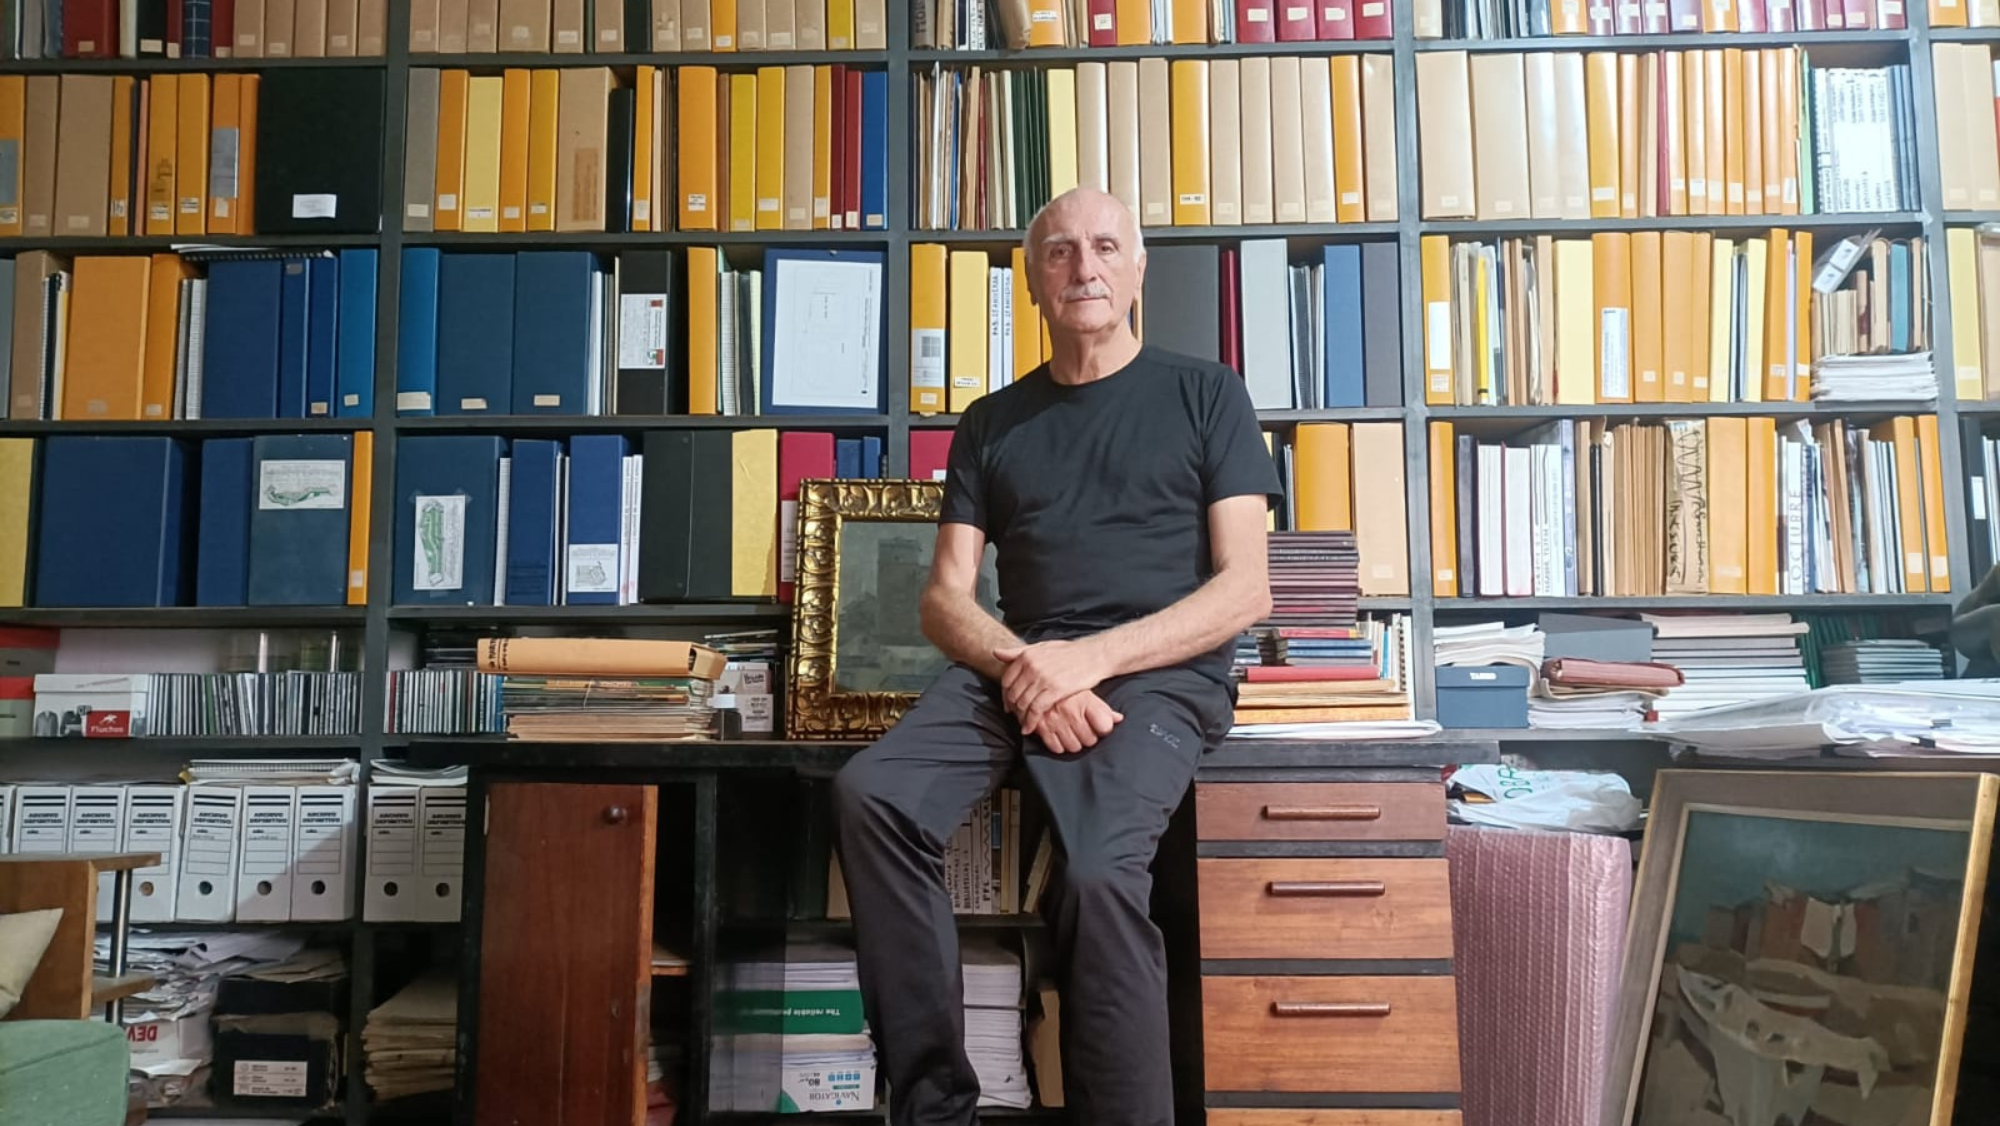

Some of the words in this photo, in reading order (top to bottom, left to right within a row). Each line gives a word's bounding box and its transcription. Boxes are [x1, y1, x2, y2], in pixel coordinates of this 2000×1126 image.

[1789, 491, 1802, 581] OCTUBRE
[825, 1008, 840, 1016] The
[809, 1091, 860, 1101] NAVIGATOR
